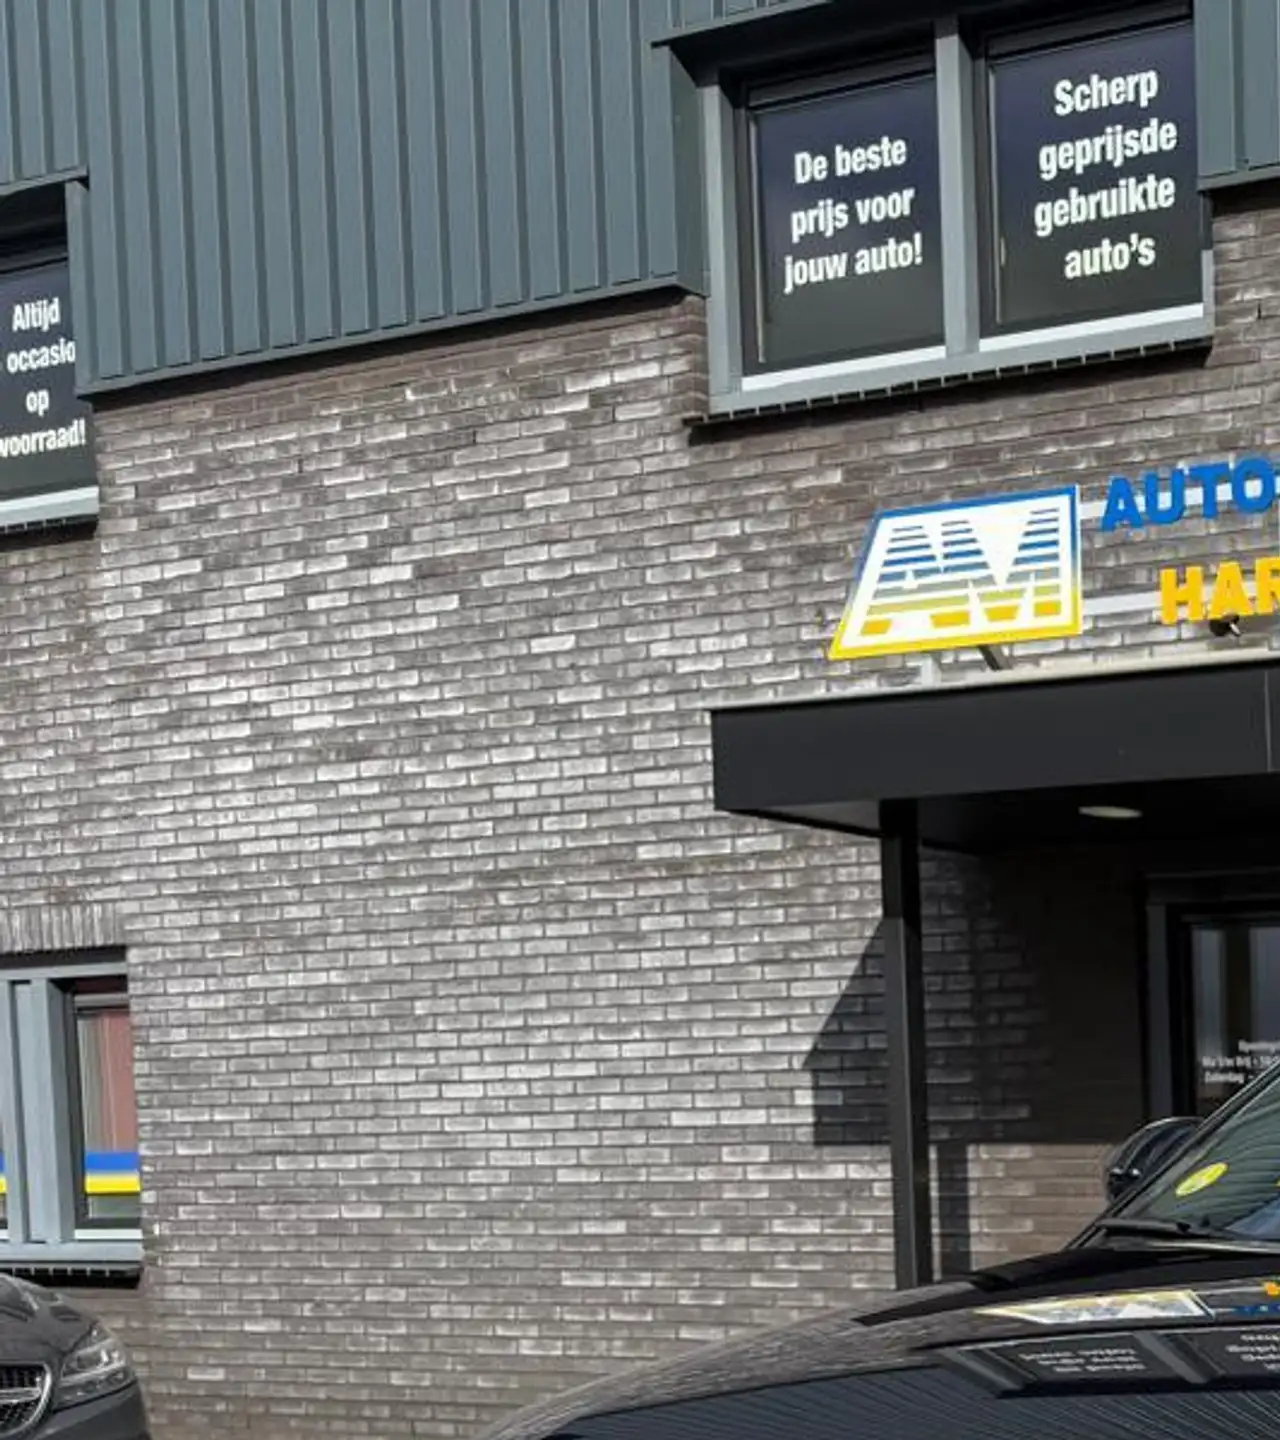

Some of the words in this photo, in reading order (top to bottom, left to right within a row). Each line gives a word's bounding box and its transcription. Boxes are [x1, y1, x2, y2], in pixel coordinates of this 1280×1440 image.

[1053, 68, 1158, 117] Scherp
[794, 151, 828, 185] De
[835, 135, 907, 175] beste
[1038, 118, 1178, 181] geprijsde
[790, 203, 849, 244] prijs
[856, 186, 914, 223] voor
[1033, 173, 1175, 238] gebruikte
[783, 253, 848, 295] jouw
[854, 233, 923, 276] auto!
[1064, 232, 1156, 280] auto's
[12, 297, 60, 331] Altijd
[6, 338, 76, 374] occasio
[25, 389, 50, 418] op
